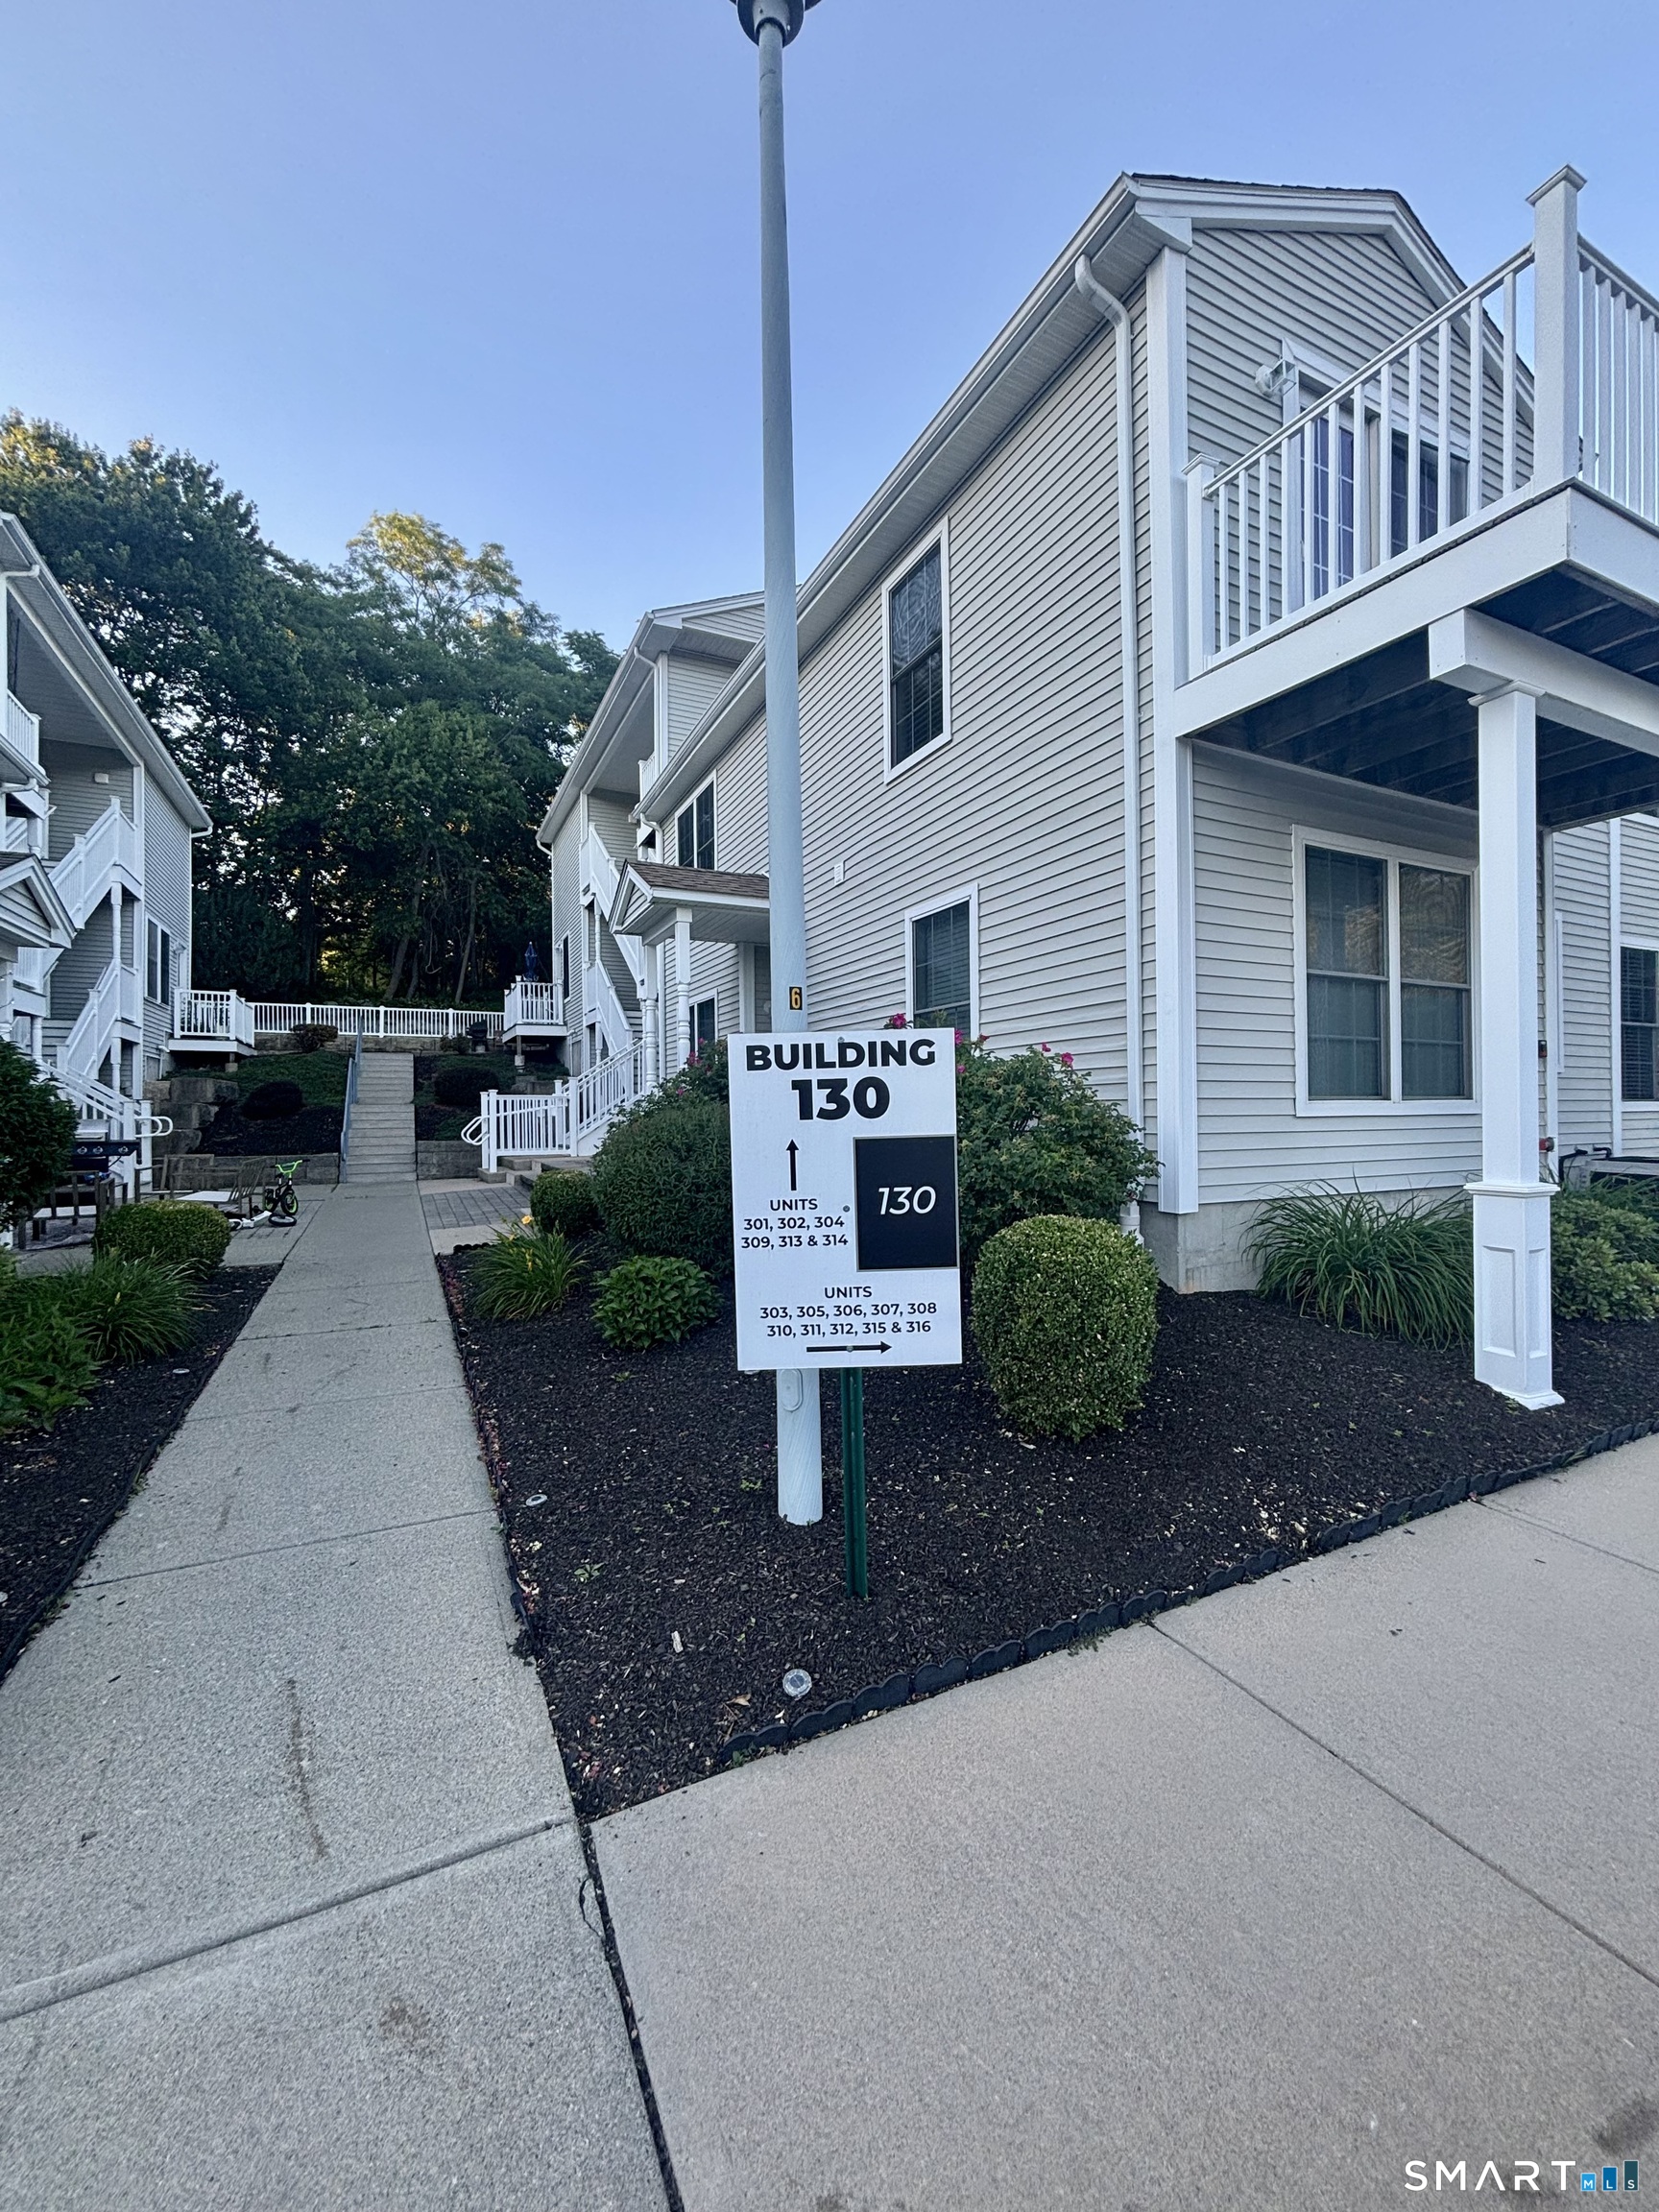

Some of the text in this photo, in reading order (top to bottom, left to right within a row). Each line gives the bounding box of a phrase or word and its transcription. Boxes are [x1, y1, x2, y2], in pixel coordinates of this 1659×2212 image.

[791, 987, 801, 1009] 6
[746, 1039, 936, 1071] BUILDING
[791, 1076, 890, 1120] 130
[770, 1198, 818, 1211] UNITS
[878, 1186, 937, 1215] 130
[743, 1215, 845, 1232] 301, 302, 304
[740, 1234, 850, 1250] 309, 313 & 314
[824, 1286, 873, 1299] UNITS
[759, 1303, 937, 1320] 303, 305, 306, 307, 308
[767, 1320, 931, 1338] 310, 311, 312, 315 & 316
